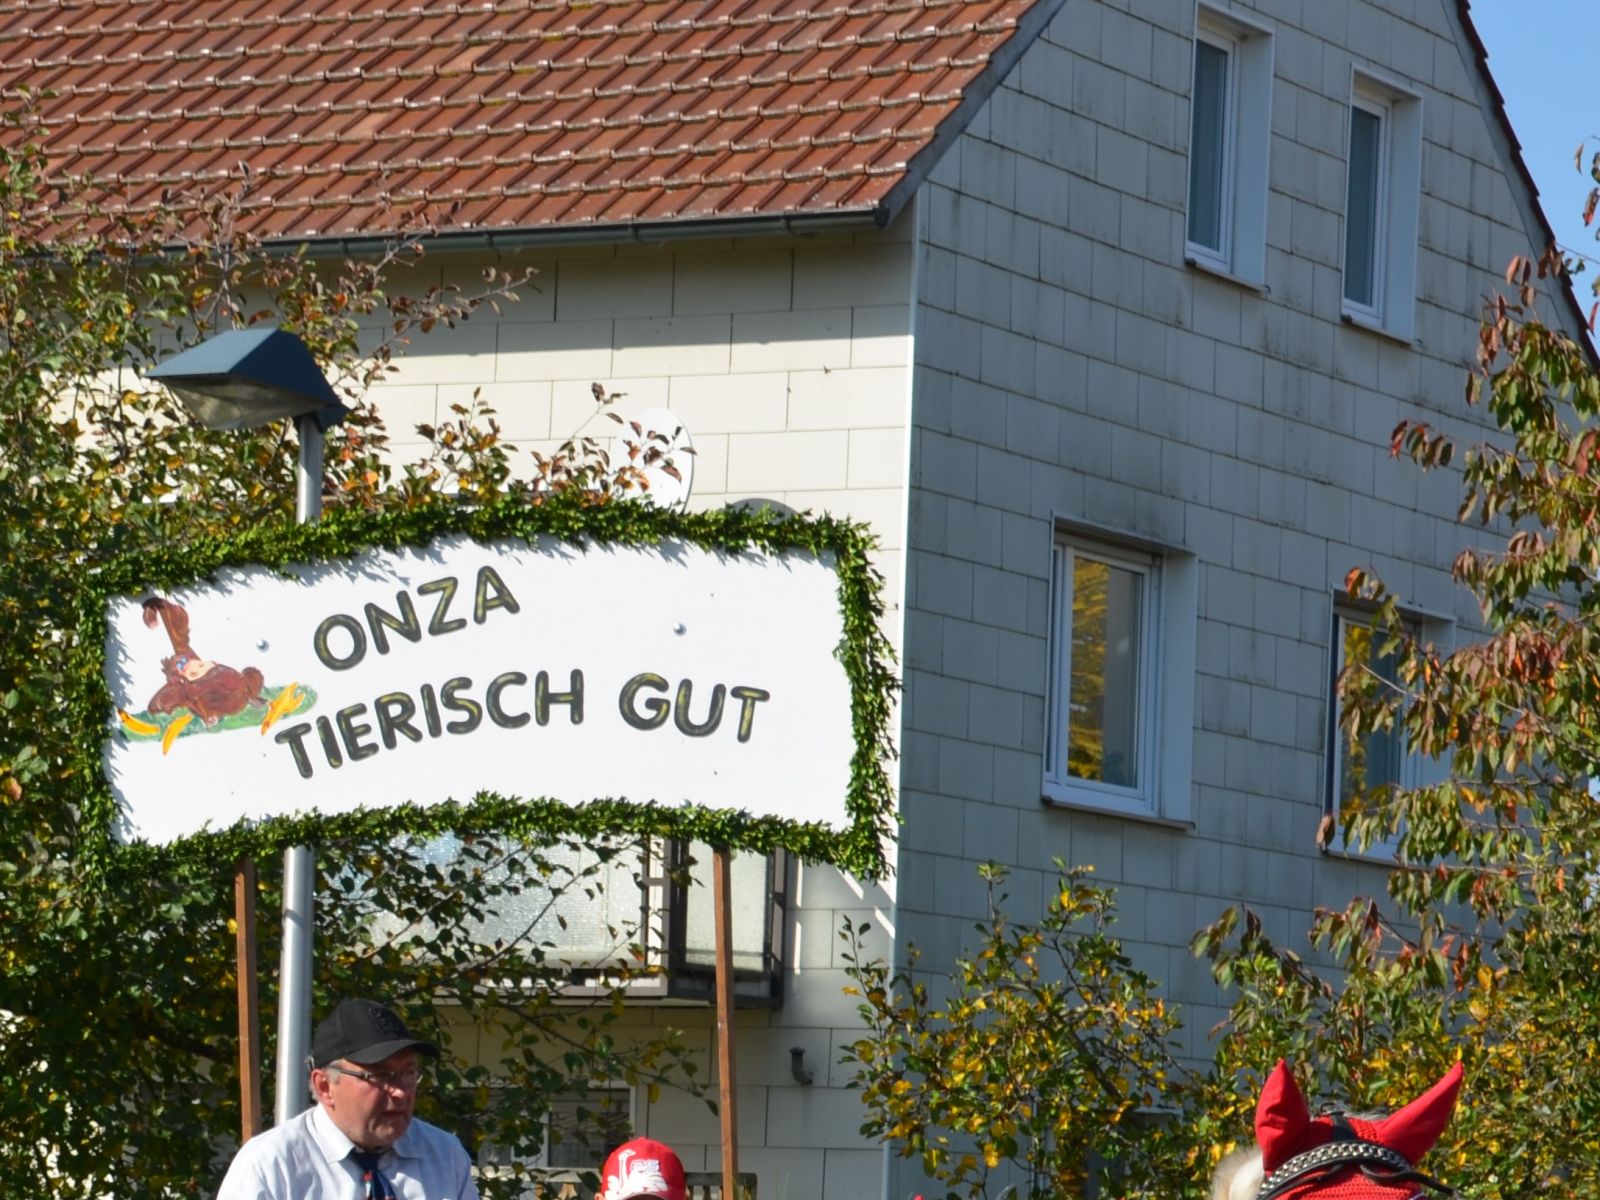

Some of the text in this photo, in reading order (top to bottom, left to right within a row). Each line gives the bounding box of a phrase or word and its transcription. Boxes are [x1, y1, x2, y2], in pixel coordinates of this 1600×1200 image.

[314, 566, 520, 670] ONZA
[275, 669, 769, 778] TIERISCH GUT
